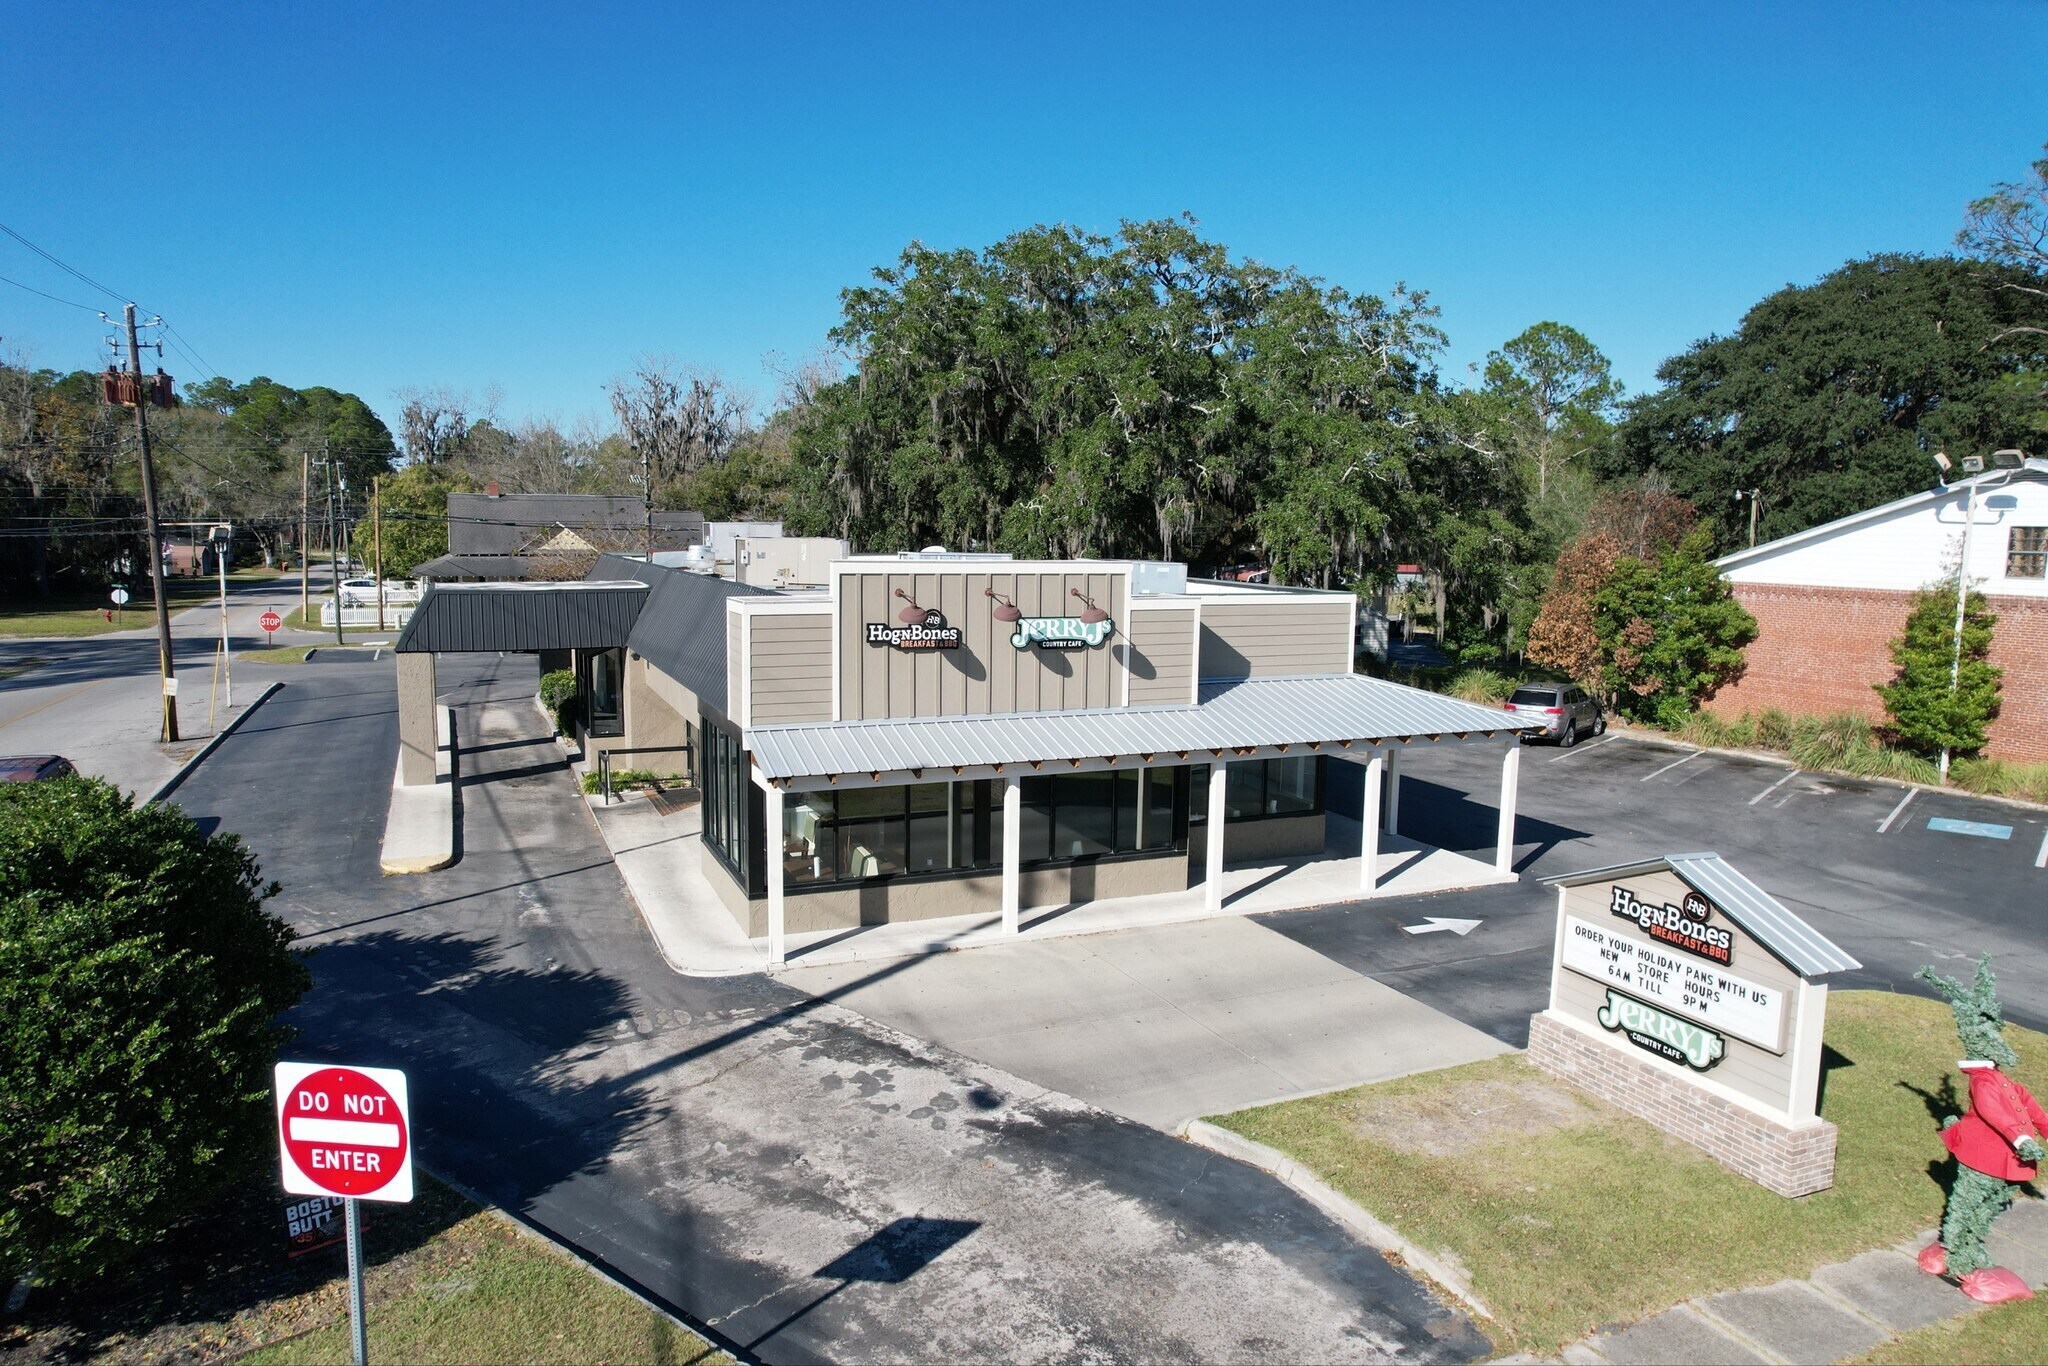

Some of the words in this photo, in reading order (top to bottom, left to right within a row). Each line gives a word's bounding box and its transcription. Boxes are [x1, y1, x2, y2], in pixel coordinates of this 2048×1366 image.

[261, 617, 280, 626] STOP
[1686, 898, 1706, 917] HNB
[1575, 925, 1604, 945] ORDER
[1608, 937, 1633, 955] YOUR
[1638, 948, 1682, 973] HOLIDAY
[1686, 966, 1714, 986] PANS
[1718, 978, 1746, 999] WITH
[1752, 991, 1767, 1006] US
[1600, 947, 1619, 963] NEW
[1637, 962, 1669, 983] STORE
[1684, 979, 1720, 1003] HOURS
[1639, 976, 1662, 995] TILL
[1632, 1033, 1662, 1051] COUNTRY
[1662, 1045, 1680, 1059] CAFE
[298, 1091, 329, 1112] DO
[343, 1093, 386, 1116] NOT
[311, 1149, 381, 1173] ENTER
[286, 1196, 345, 1222] BOSTO
[288, 1209, 333, 1237] BUTT
